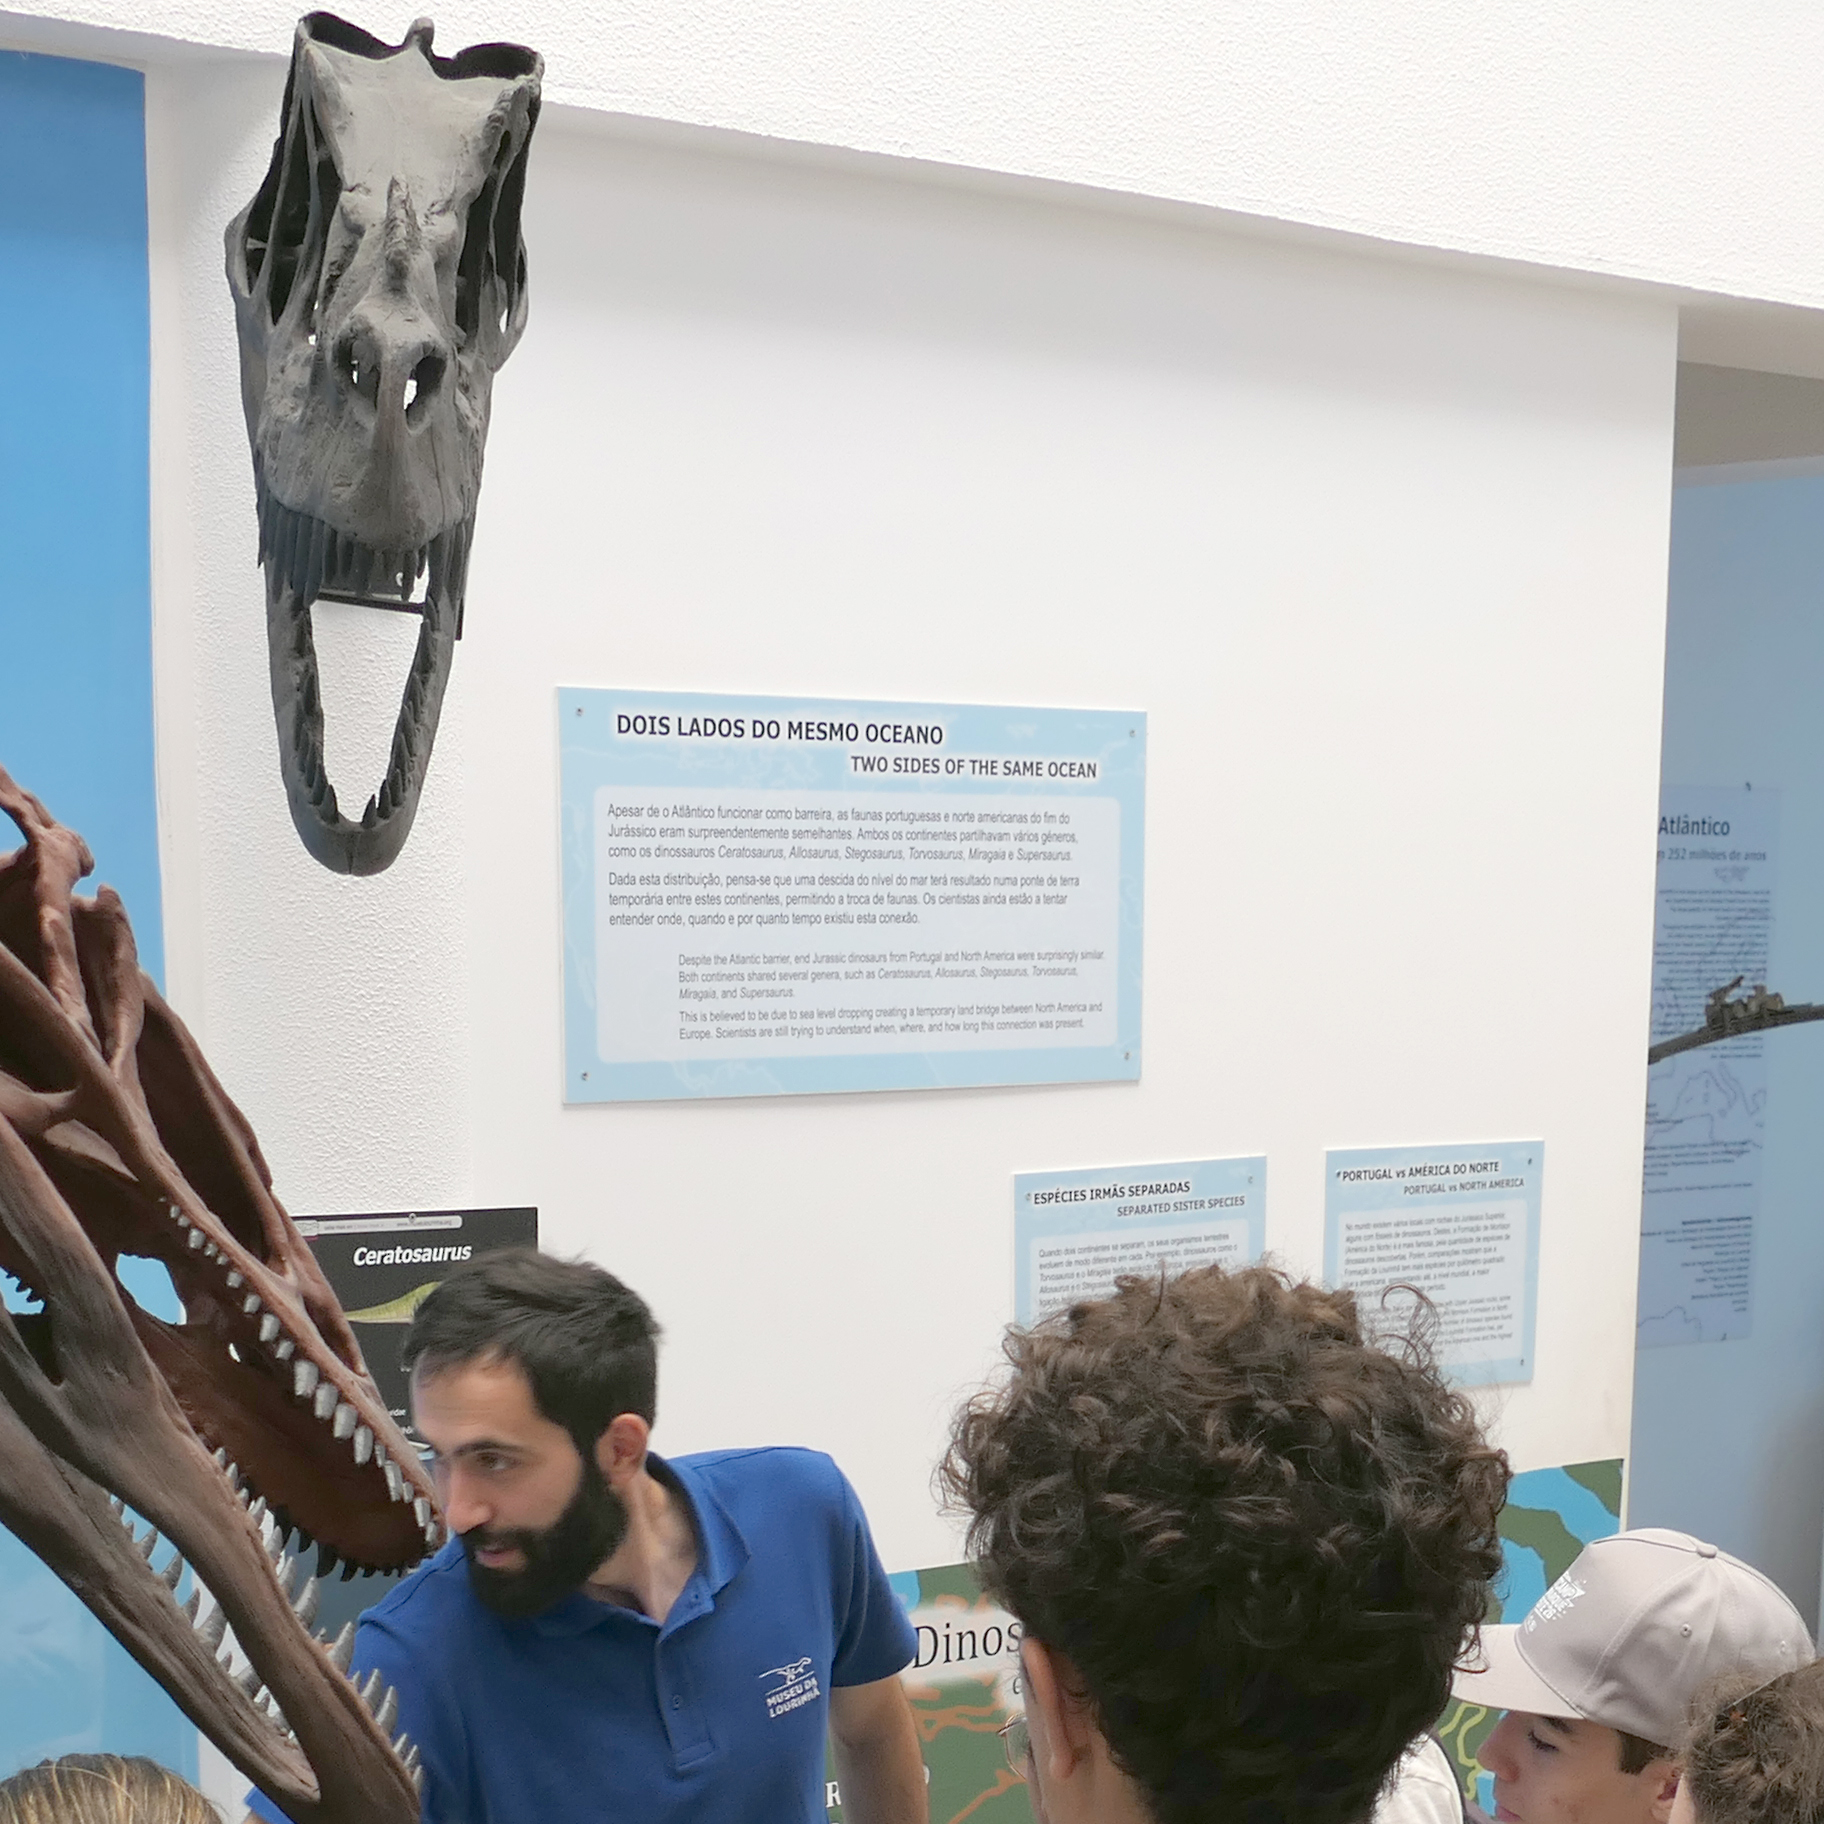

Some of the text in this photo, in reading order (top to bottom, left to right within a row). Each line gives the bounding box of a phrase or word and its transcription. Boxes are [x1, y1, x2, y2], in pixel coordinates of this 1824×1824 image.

[617, 714, 943, 745] DOIS LADOS DO MESMO OCEANO
[850, 755, 1096, 778] TWO SIDES OF THE SAME OCEAN
[607, 803, 644, 820] Apesar
[646, 804, 660, 817] de
[671, 804, 715, 818] Atlântico
[717, 805, 763, 819] funcionar
[765, 809, 792, 819] como
[837, 810, 848, 820] as
[851, 807, 882, 821] faunas
[885, 809, 941, 825] portuguesas
[952, 811, 975, 822] norte
[977, 811, 1028, 823] americanas
[1030, 812, 1041, 823] do
[1043, 811, 1056, 823] fim
[1058, 812, 1070, 824] do
[1658, 814, 1730, 836] Atlântico
[608, 823, 656, 837] Jurássico
[658, 827, 685, 838] eram
[687, 825, 789, 841] surpreendentemente
[856, 827, 889, 840] Ambos
[891, 830, 903, 840] os
[905, 829, 957, 841] continentes
[959, 829, 1010, 843] partilhavam
[1013, 830, 1039, 842] vários
[608, 846, 636, 857] como
[639, 847, 651, 857] os
[654, 844, 715, 858] dinossauros
[968, 847, 1006, 863] Miragaia
[608, 871, 636, 885] Dada
[638, 873, 660, 885] esta
[725, 875, 771, 888] pensa-se
[773, 875, 791, 888] que
[794, 875, 815, 885] uma
[817, 873, 854, 885] descida
[856, 873, 869, 885] do
[871, 873, 893, 886] nível
[895, 874, 907, 886] do
[910, 876, 928, 886] mar
[930, 873, 947, 885] terá
[950, 874, 991, 886] resultado
[993, 876, 1018, 886] numa
[1020, 875, 1044, 888] ponte
[1046, 874, 1057, 886] de
[1059, 875, 1079, 886] terra
[608, 892, 663, 907] temporária
[665, 893, 692, 905] entre
[694, 893, 721, 905] estes
[785, 892, 835, 907] permitindo
[846, 893, 870, 905] troca
[872, 893, 884, 904] de
[922, 892, 936, 904] Os
[938, 893, 980, 904] cientistas
[982, 893, 1006, 904] ainda
[1008, 892, 1032, 904] estão
[1042, 893, 1067, 904] tentar
[609, 912, 655, 925] entender
[687, 912, 725, 927] quando
[737, 914, 753, 927] por
[755, 912, 789, 927] quanto
[791, 912, 821, 926] tempo
[824, 912, 854, 924] existiu
[856, 912, 876, 923] esta
[1342, 1161, 1499, 1182] PORTUGAL vs AMÉRICA DO NORTE
[1034, 1181, 1191, 1205] ESPÉCIES IRMÃS SEPARADAS
[1403, 1177, 1525, 1196] PORTUGAL vs NORTH AMERICA
[1117, 1195, 1245, 1217] SEPARATED SISTER SPECIES
[353, 1244, 472, 1267] Ceratosaurus
[766, 1676, 818, 1707] MUSEU DA
